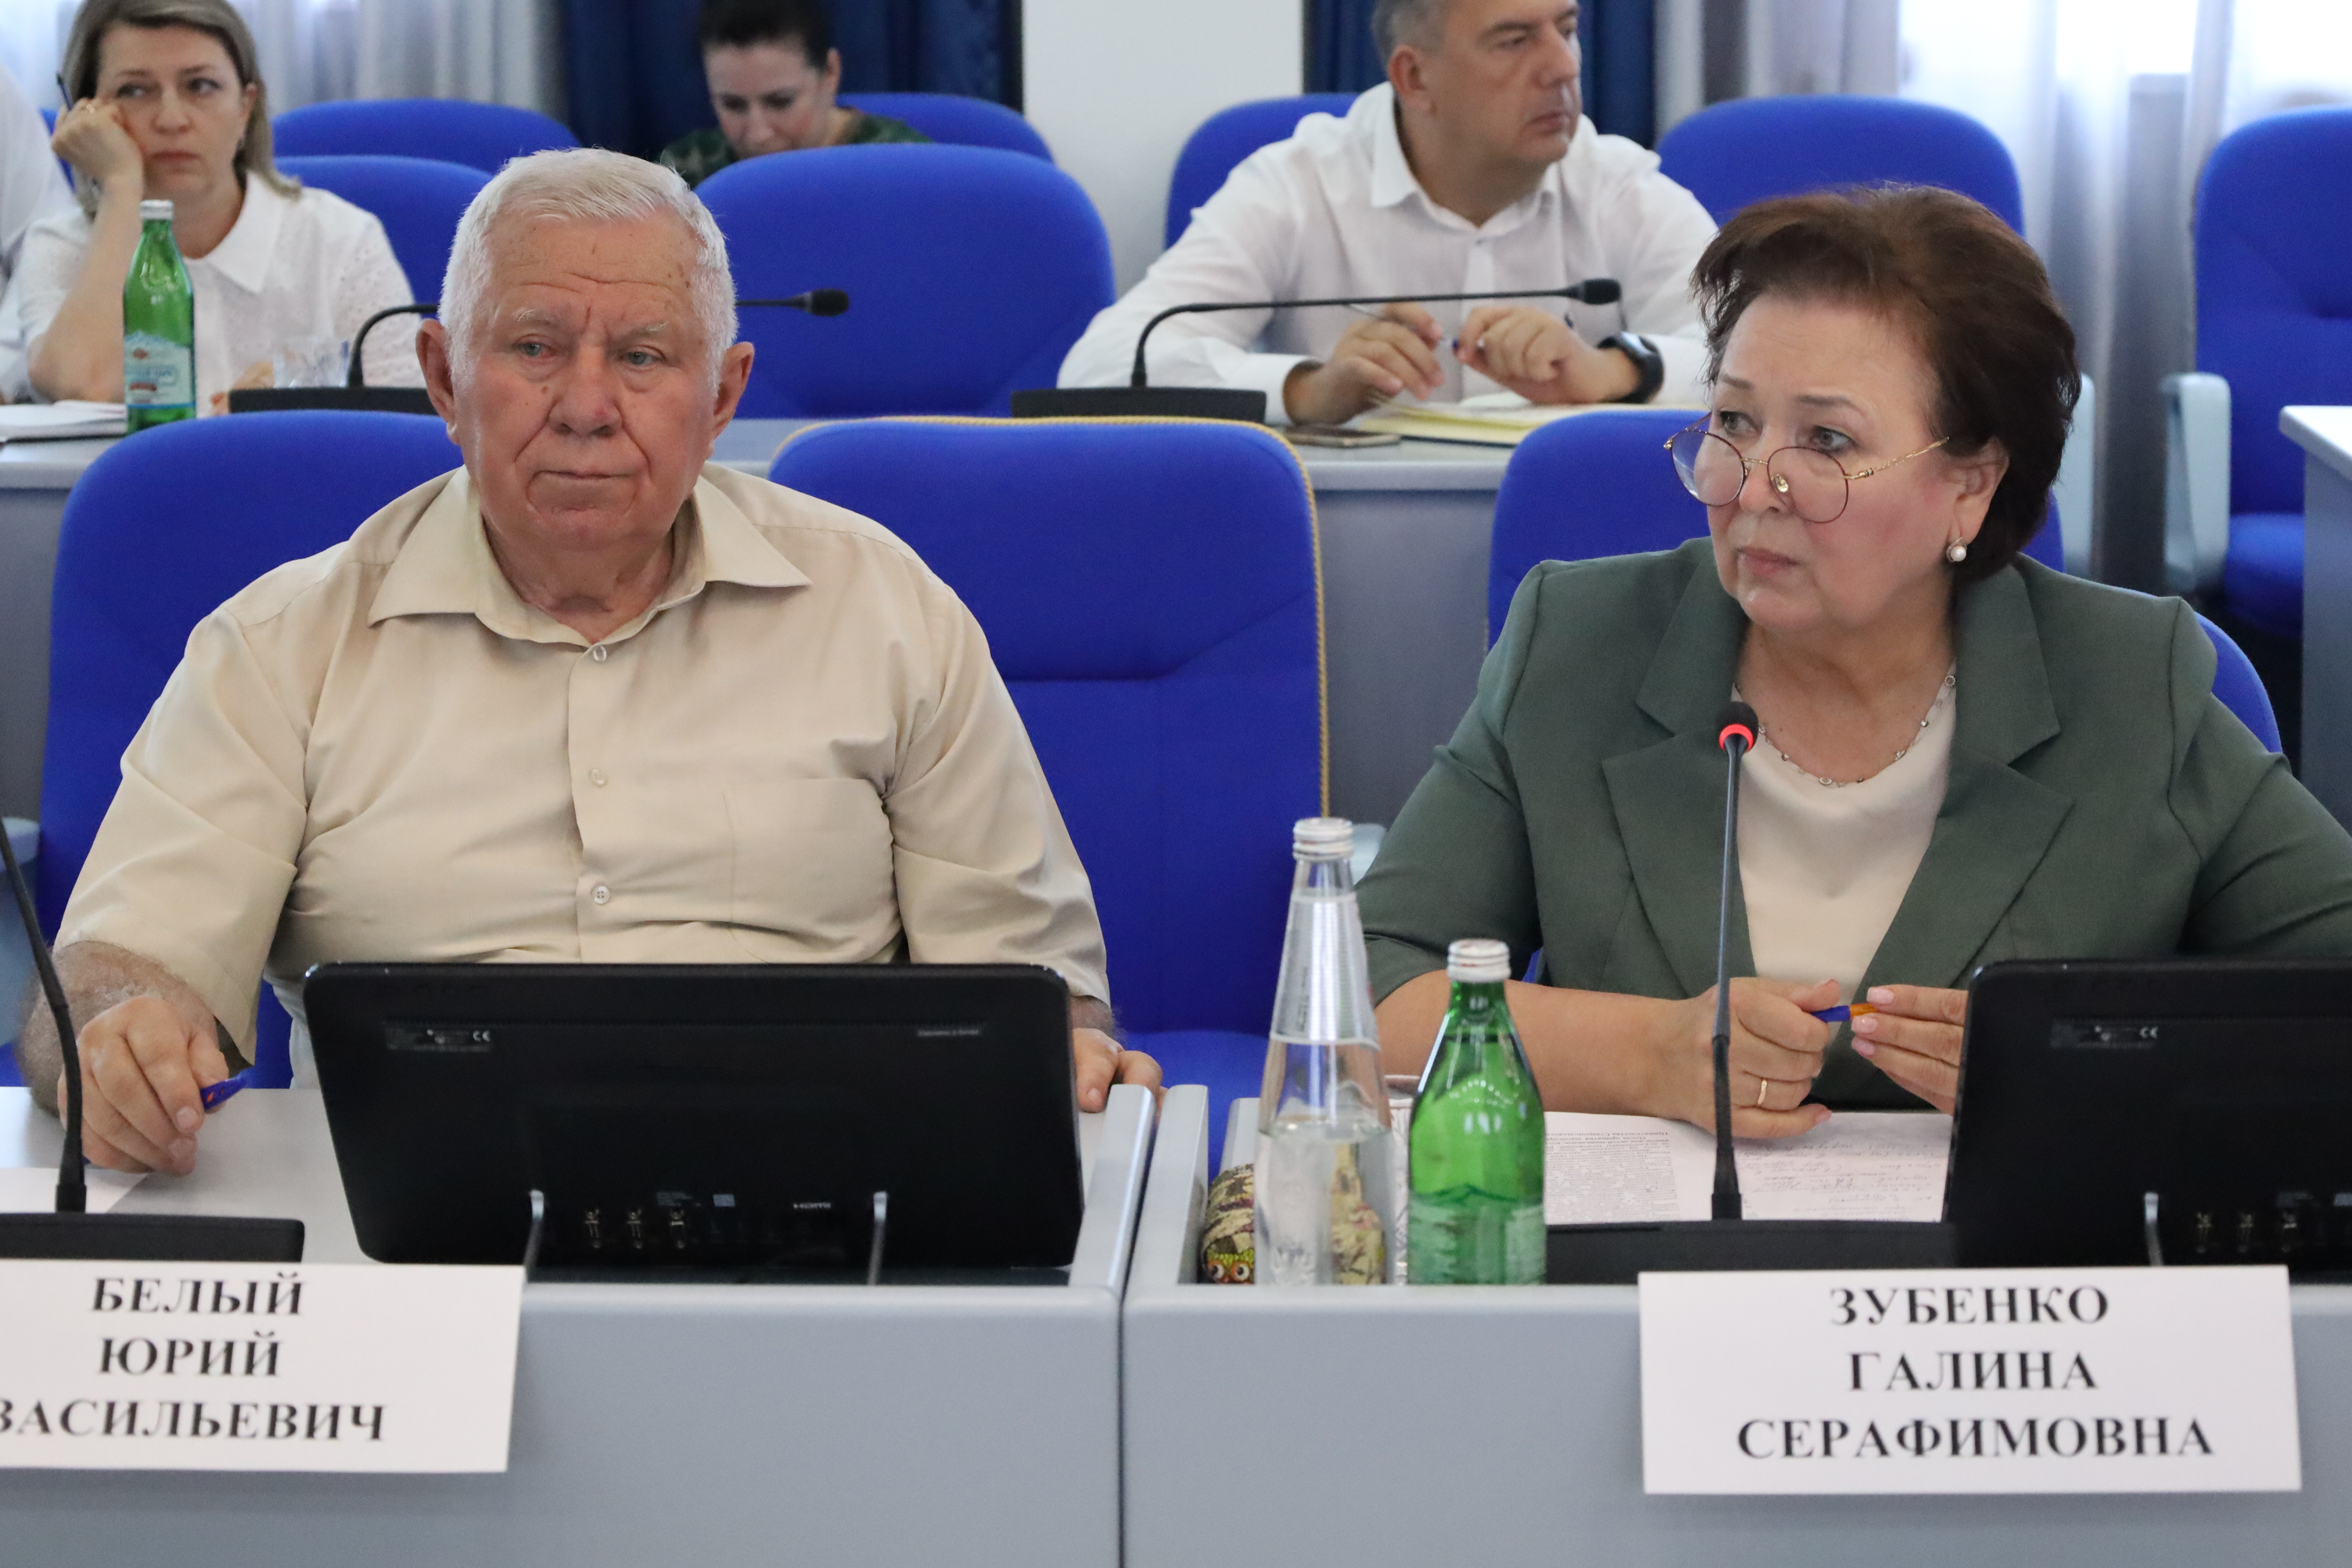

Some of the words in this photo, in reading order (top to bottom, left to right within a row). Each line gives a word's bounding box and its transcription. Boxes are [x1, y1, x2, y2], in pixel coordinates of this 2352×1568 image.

[93, 1272, 305, 1315] БЕЛЫЙ
[1831, 1286, 2109, 1325] ЗУБЕНКО
[98, 1331, 282, 1377] ЮРИЙ
[1849, 1351, 2097, 1391] ГАЛИНА
[1737, 1417, 2215, 1458] СЕРАФИМОВНА
